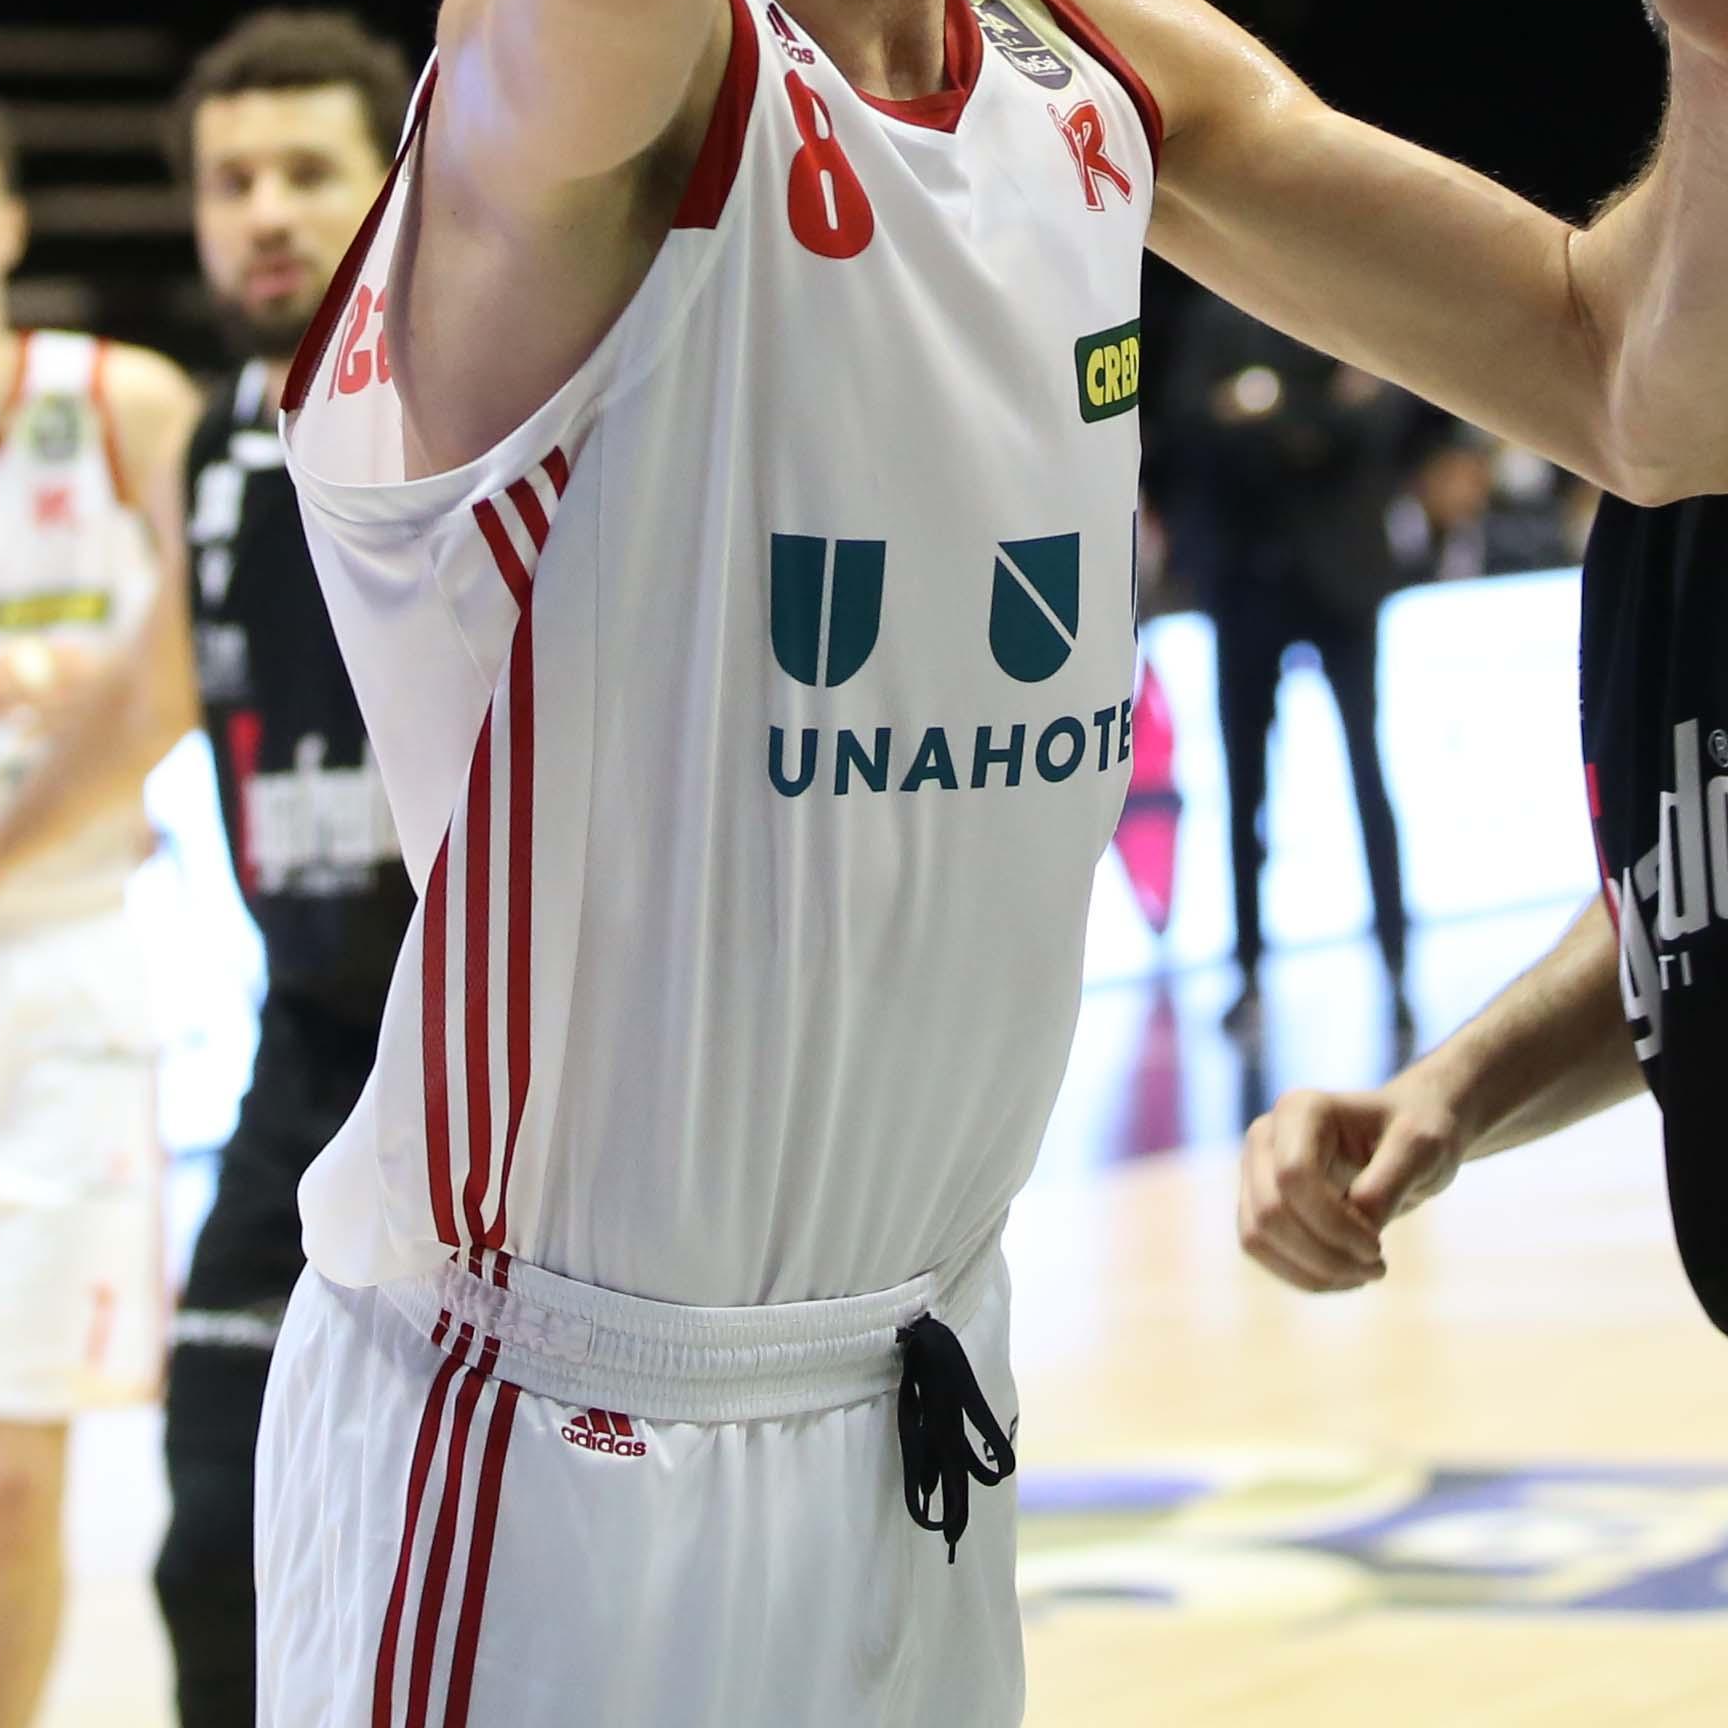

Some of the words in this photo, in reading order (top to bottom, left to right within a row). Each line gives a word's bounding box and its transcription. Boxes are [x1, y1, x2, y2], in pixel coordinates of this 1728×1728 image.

[784, 69, 875, 259] 8
[1086, 337, 1140, 406] CRED
[561, 1426, 647, 1457] adidas
